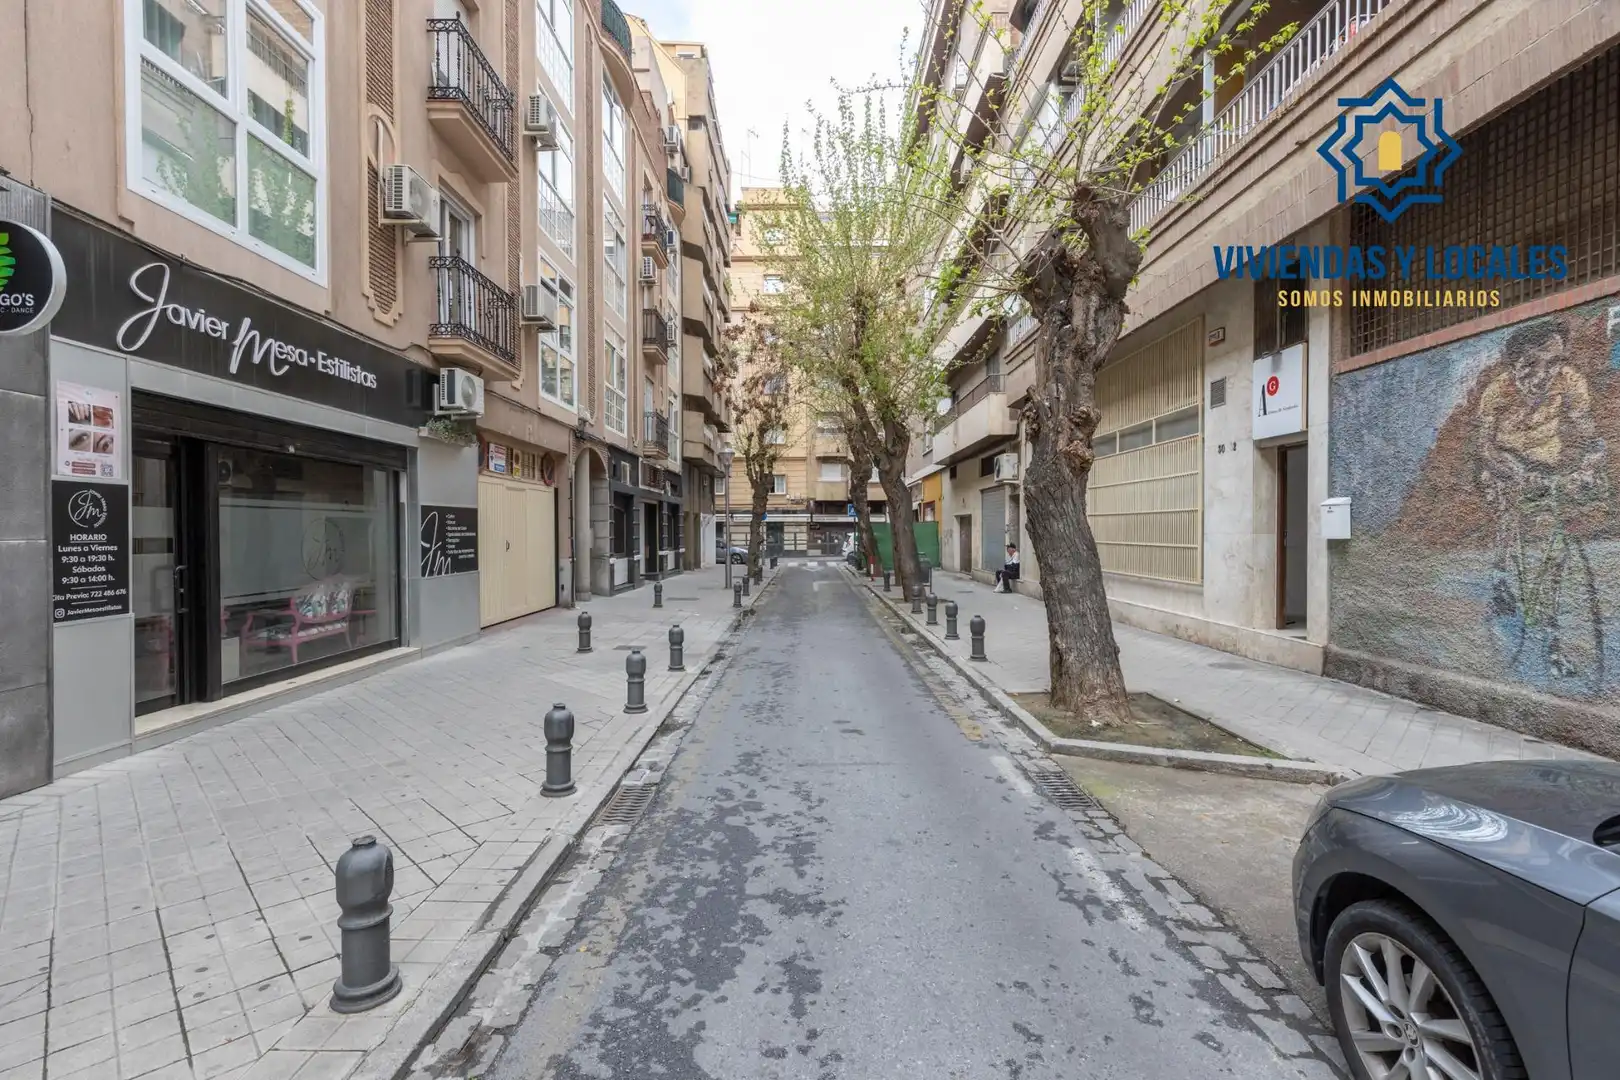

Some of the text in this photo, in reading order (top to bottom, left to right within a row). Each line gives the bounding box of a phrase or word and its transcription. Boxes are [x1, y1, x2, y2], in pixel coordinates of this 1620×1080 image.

[116, 262, 378, 389] Javier Mesa Estilistas
[72, 565, 106, 573] Sábados
[90, 590, 103, 598] 722
